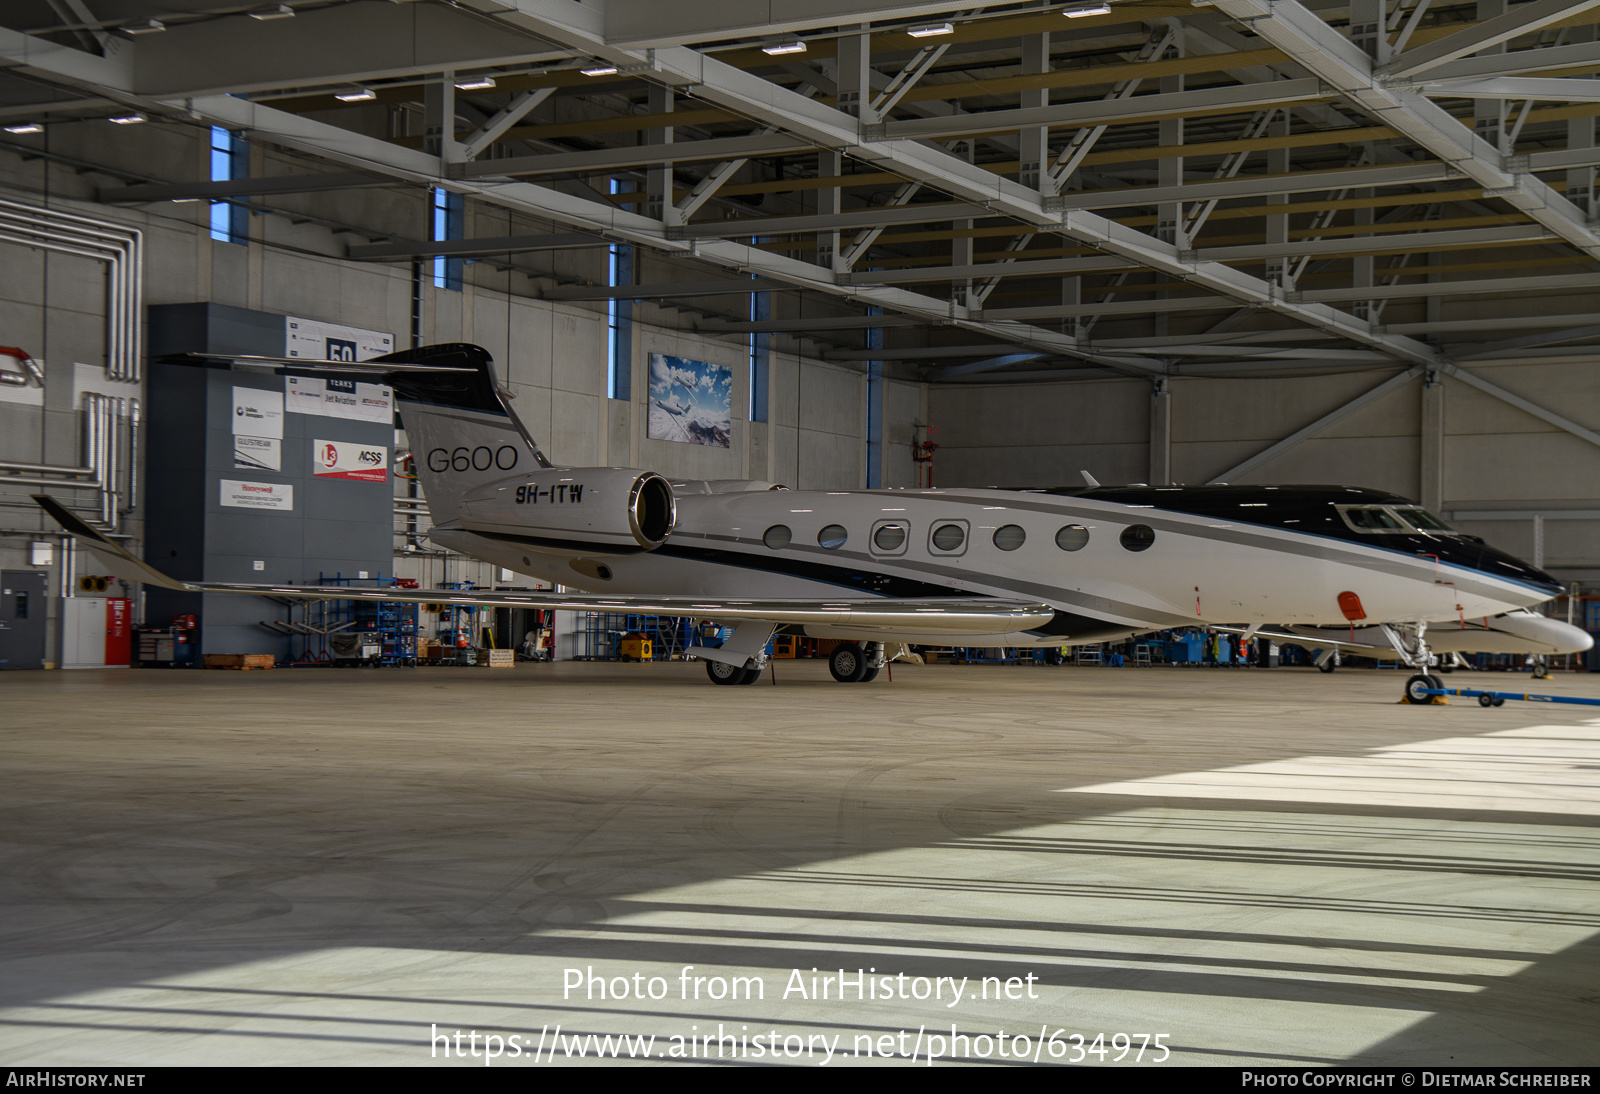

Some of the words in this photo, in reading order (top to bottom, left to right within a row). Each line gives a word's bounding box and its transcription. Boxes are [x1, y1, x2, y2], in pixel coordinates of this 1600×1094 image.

[325, 394, 334, 403] Jet
[335, 395, 356, 406] Aviation
[237, 438, 271, 447] GULFSTREAM
[323, 446, 336, 465] L3
[358, 451, 382, 464] ACSS
[427, 445, 518, 473] G600
[242, 484, 272, 493] Honeywell
[515, 484, 584, 504] 9H-ITW
